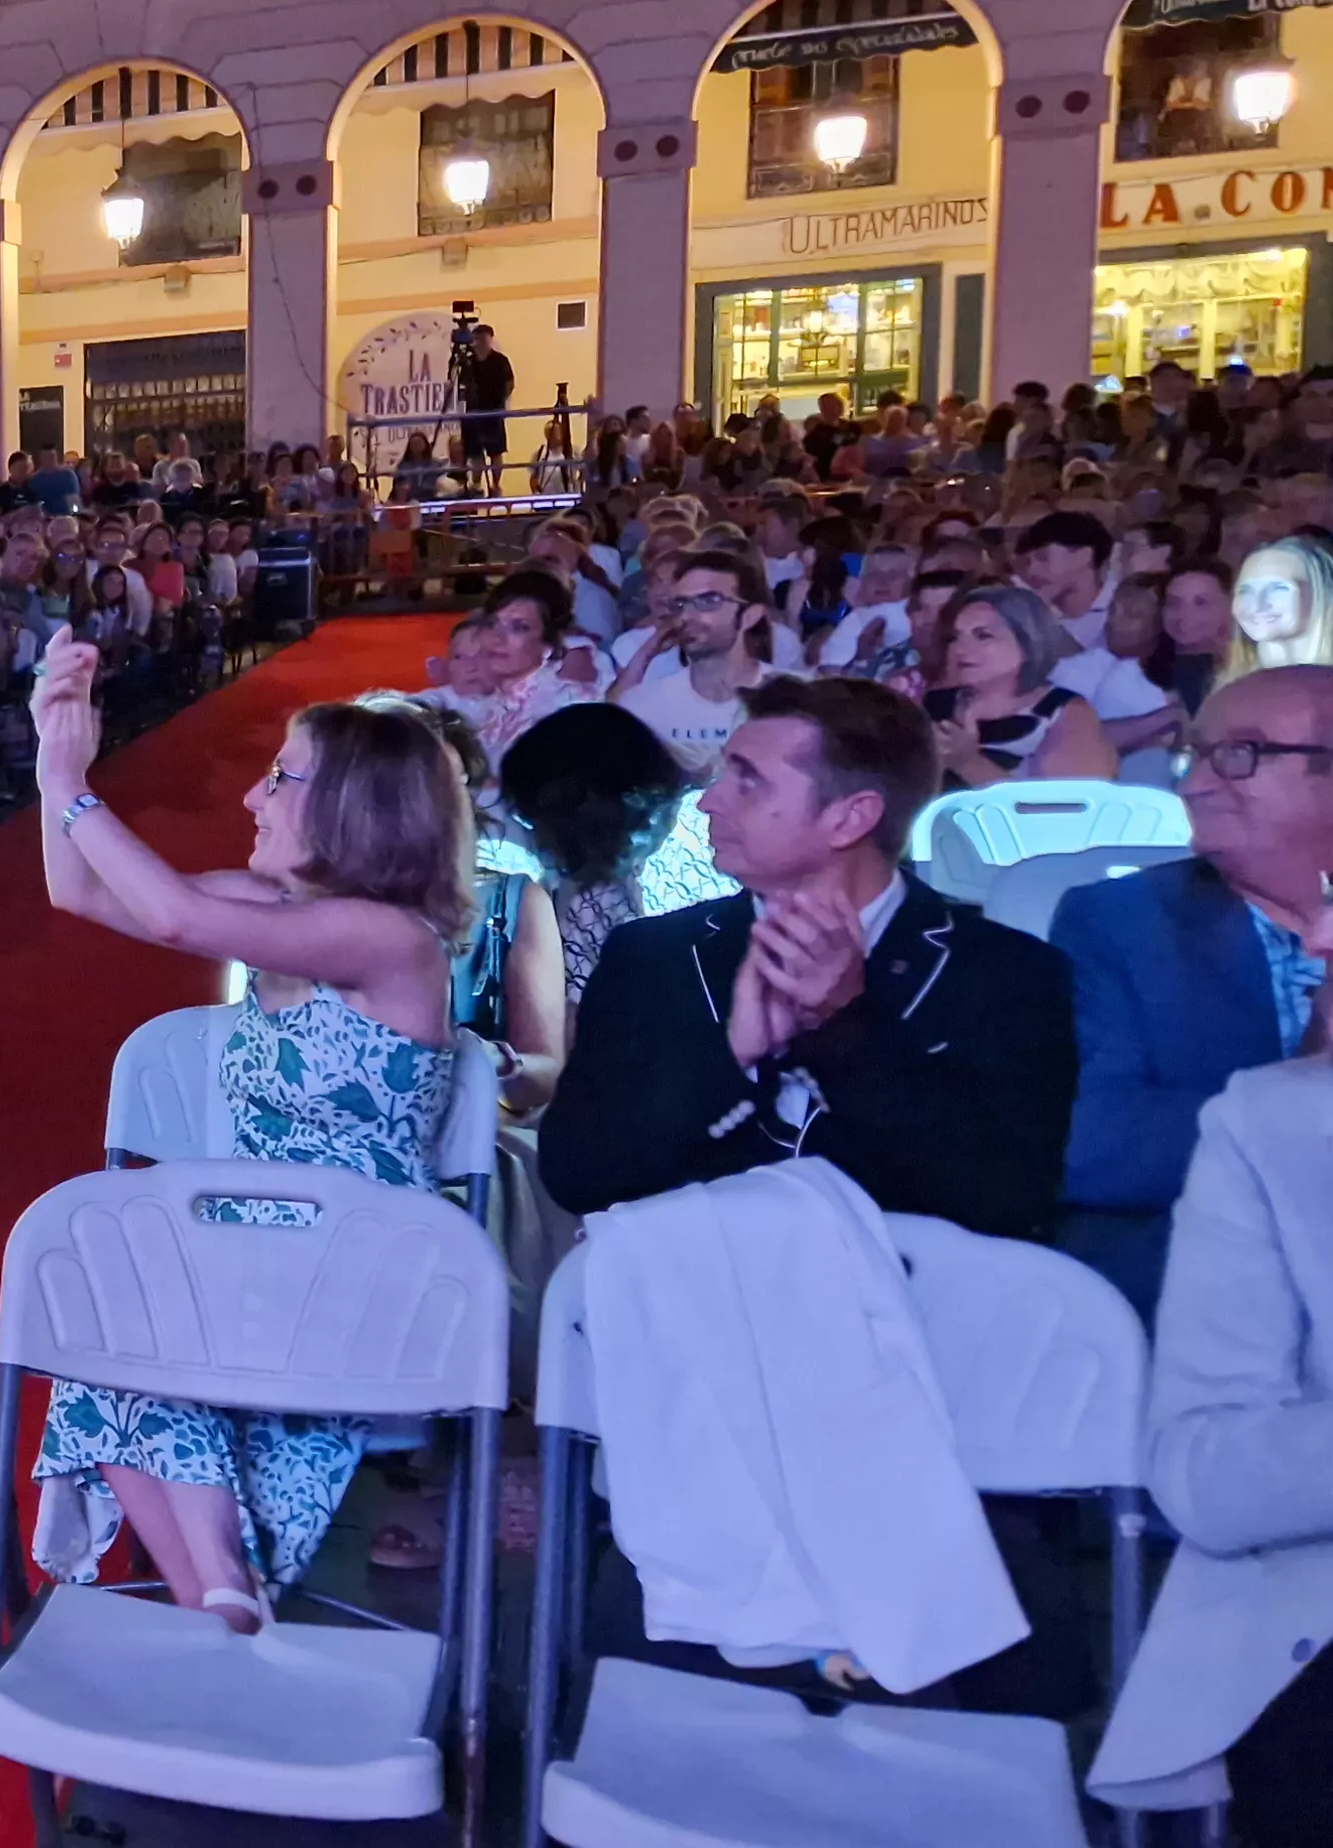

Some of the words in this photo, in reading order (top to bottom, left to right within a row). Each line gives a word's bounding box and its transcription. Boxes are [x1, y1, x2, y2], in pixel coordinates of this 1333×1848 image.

[789, 197, 988, 254] ULTRAMARINOS
[1101, 181, 1181, 229] LA
[408, 349, 432, 383] LA
